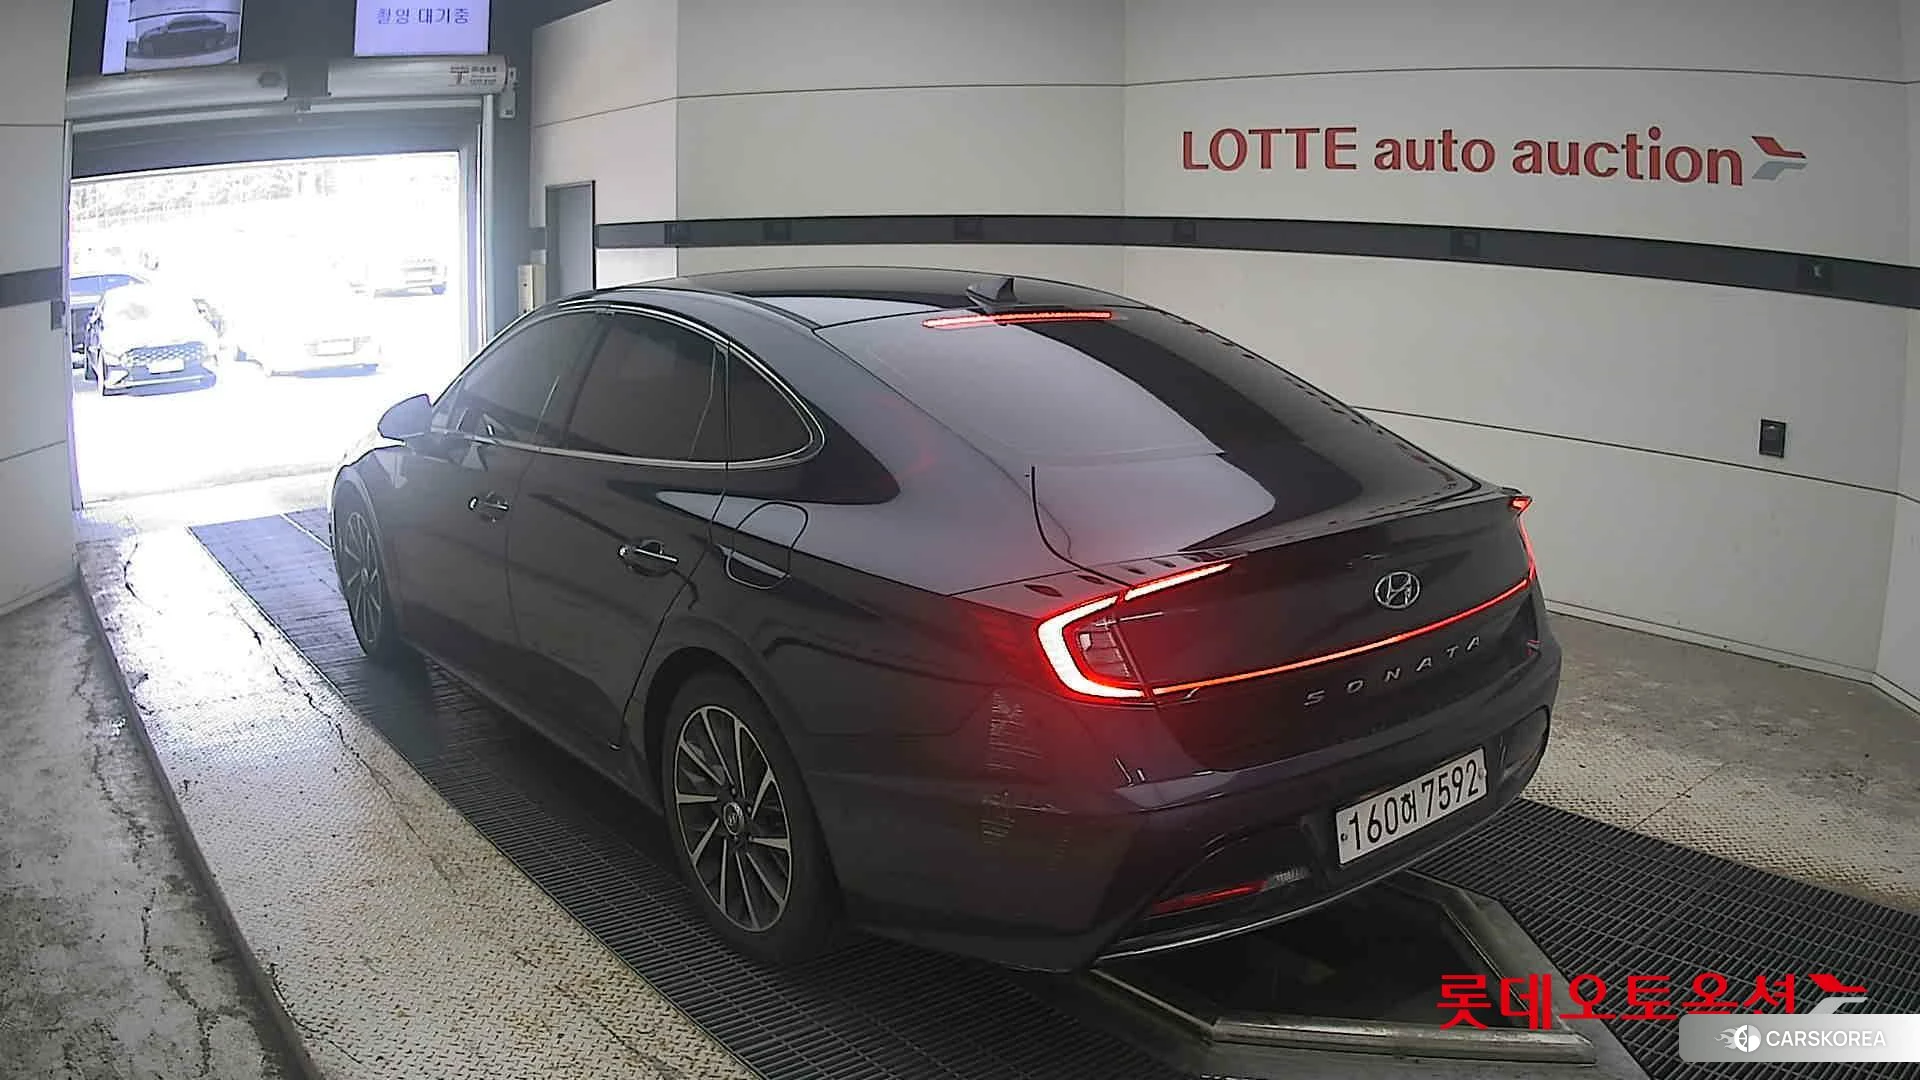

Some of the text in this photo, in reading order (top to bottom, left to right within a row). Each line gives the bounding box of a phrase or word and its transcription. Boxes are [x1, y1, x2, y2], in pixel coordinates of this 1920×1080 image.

[418, 8, 471, 24] 대기중
[1182, 126, 1743, 186] LOTTE auto auction
[1304, 635, 1481, 707] SONATA
